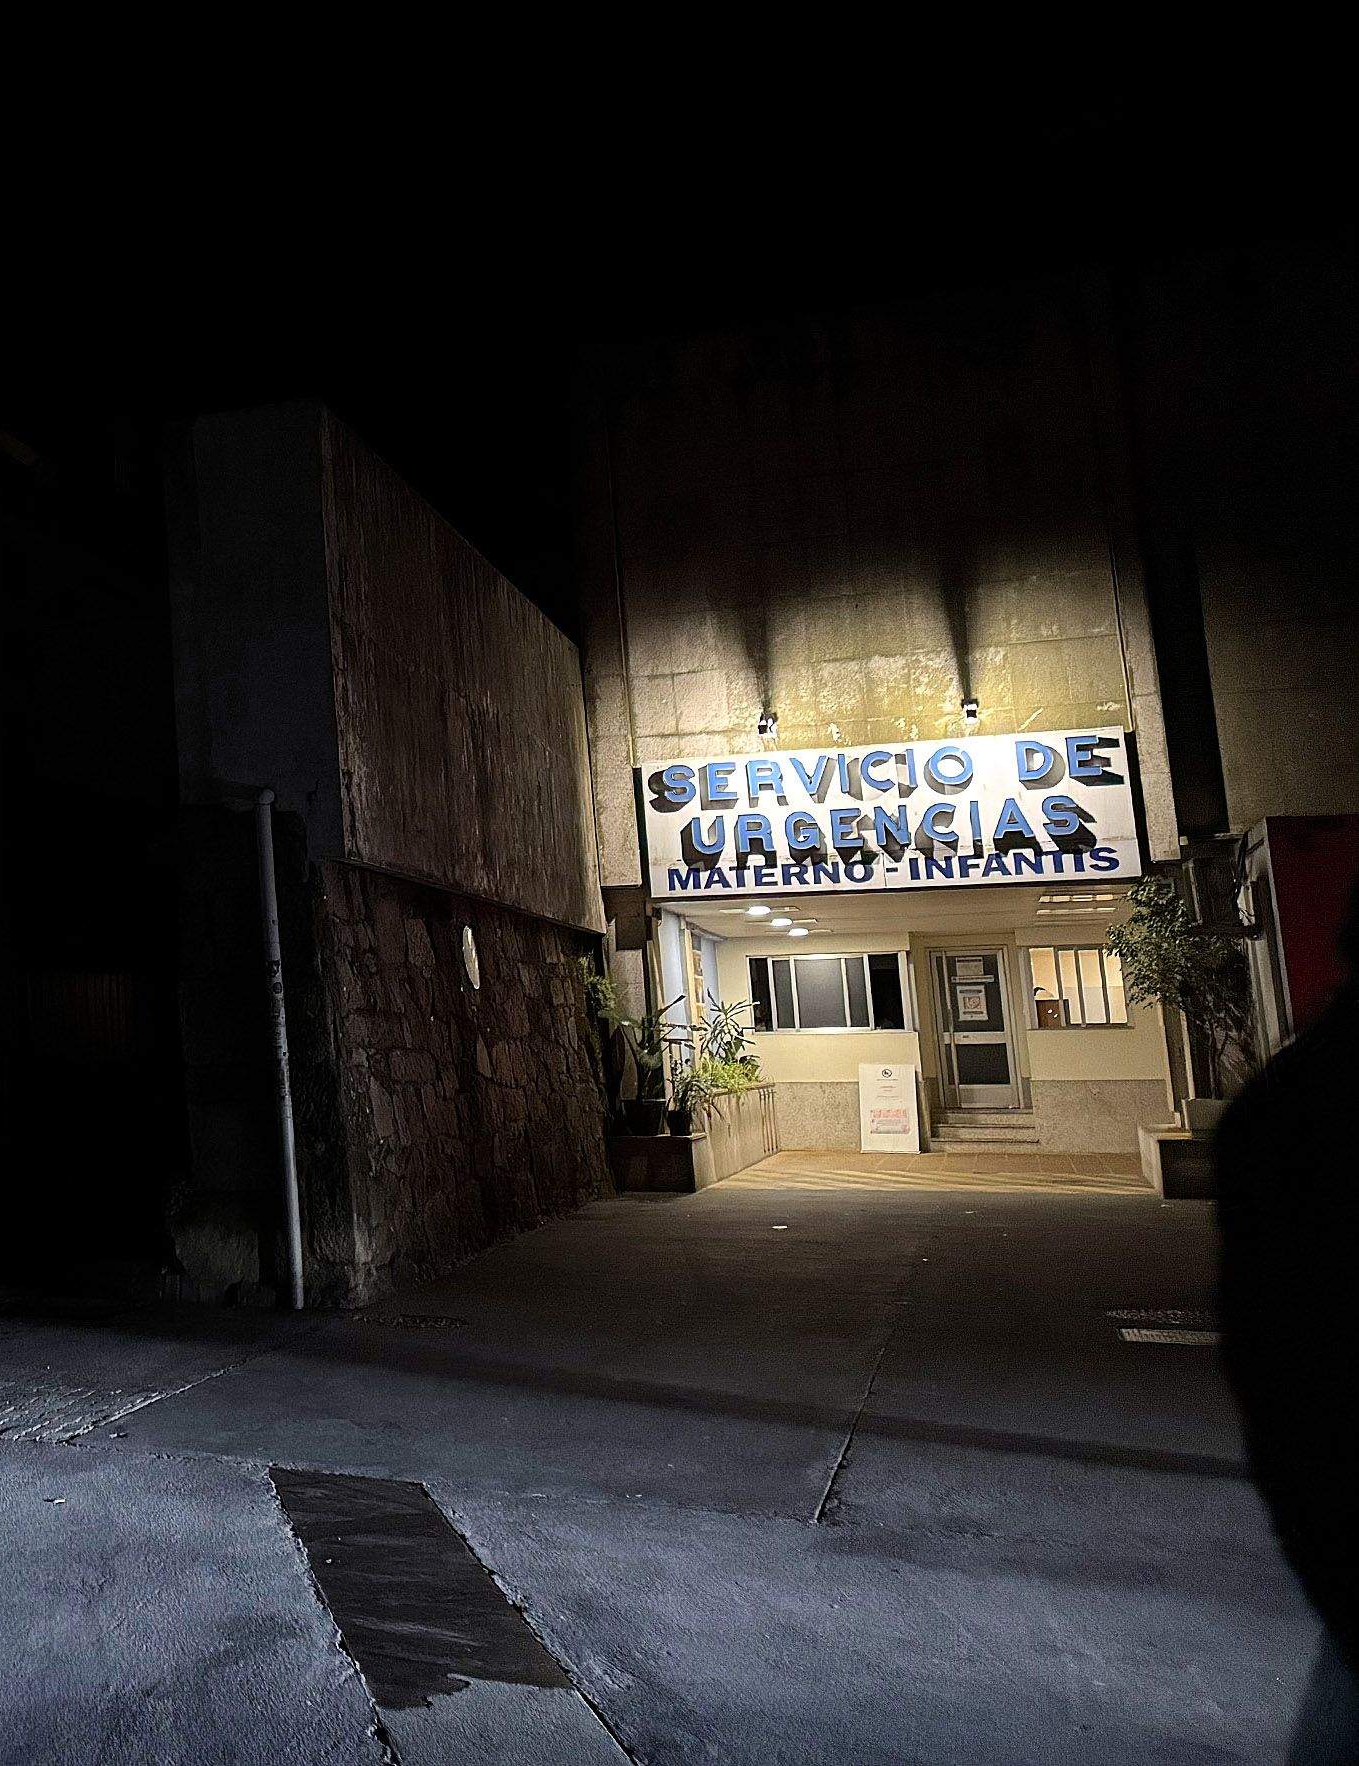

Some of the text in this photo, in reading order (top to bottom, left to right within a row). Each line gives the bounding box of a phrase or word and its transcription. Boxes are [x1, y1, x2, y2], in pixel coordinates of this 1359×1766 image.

[662, 734, 1103, 803] SERVICIO DE
[692, 795, 1081, 854] URGENCIAS
